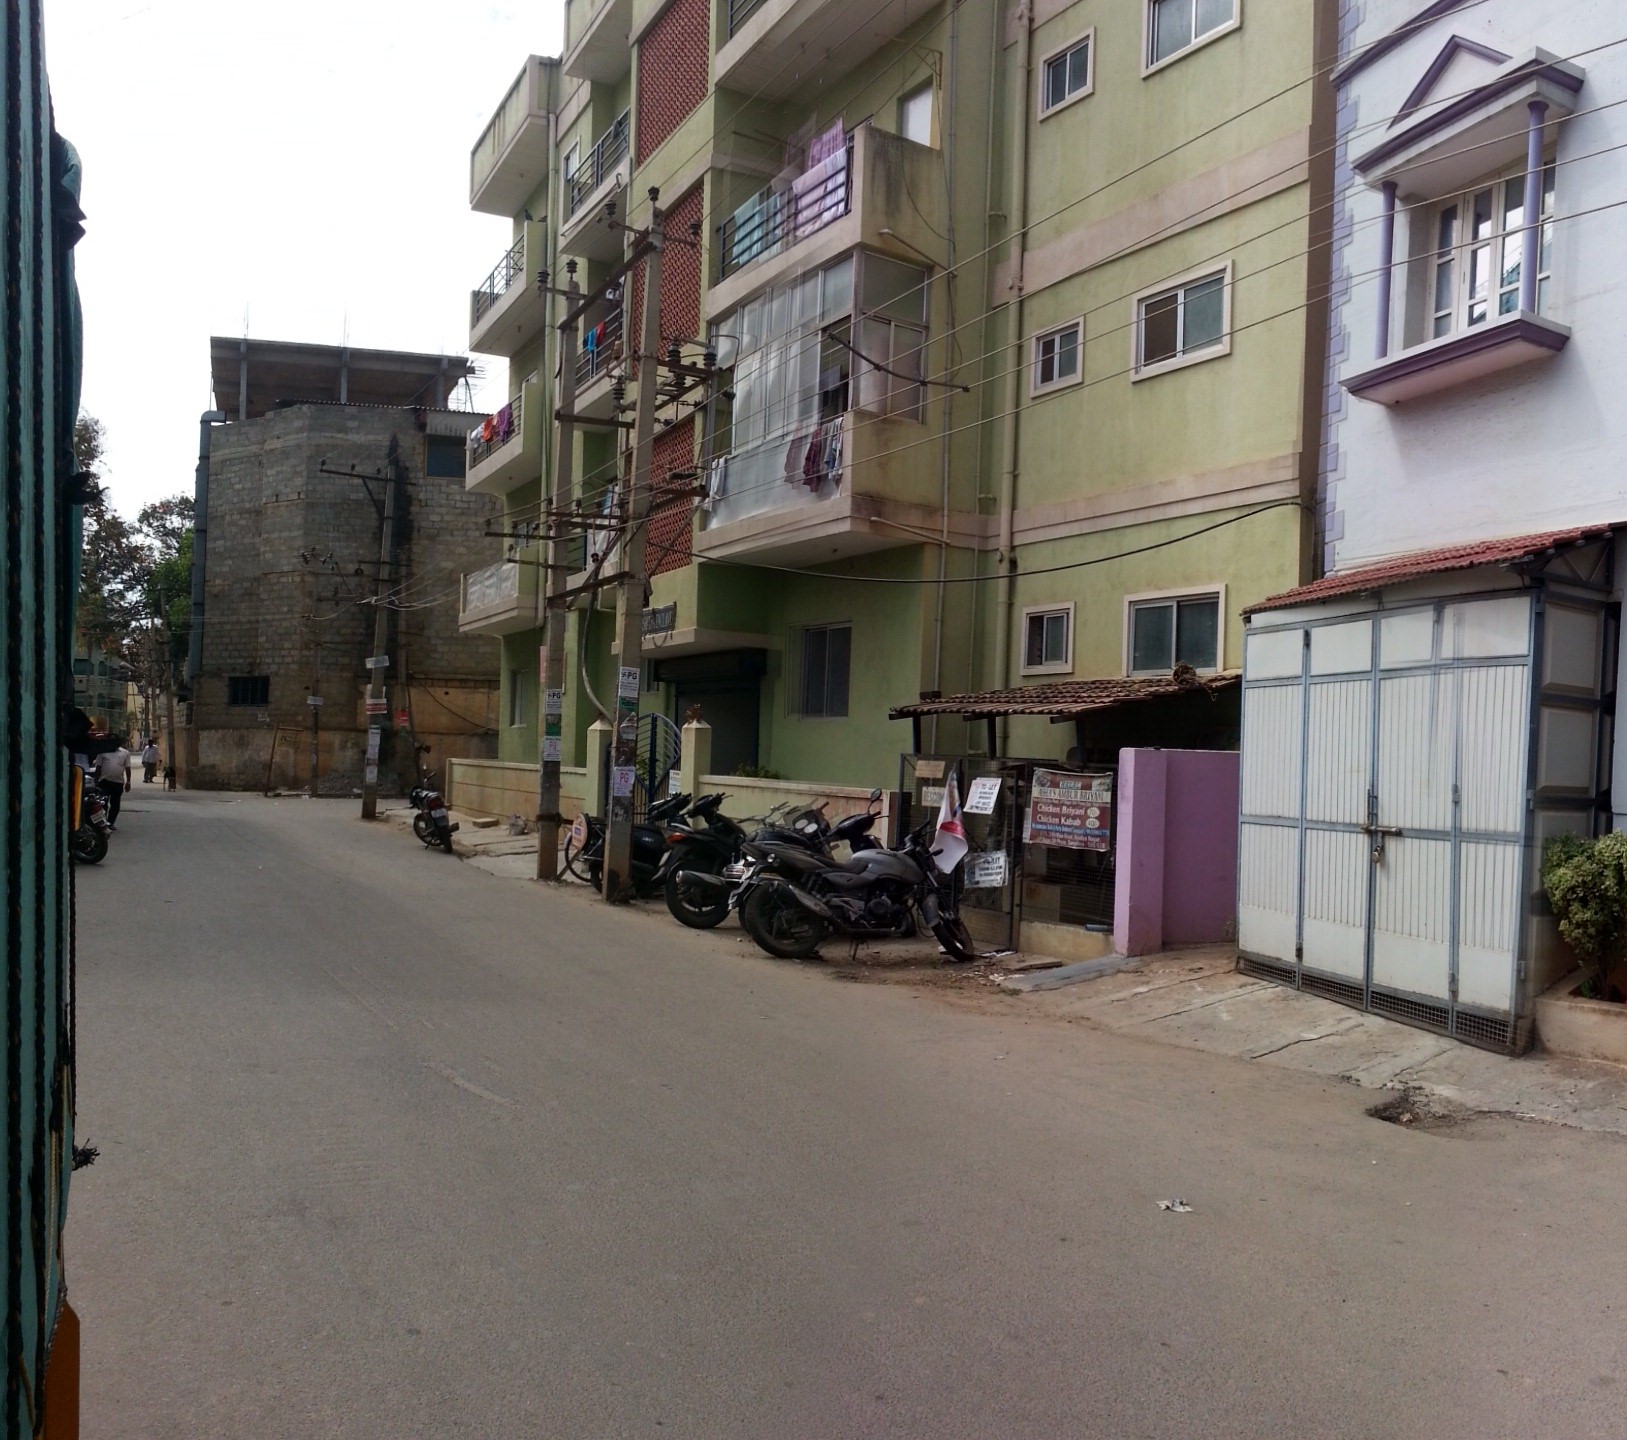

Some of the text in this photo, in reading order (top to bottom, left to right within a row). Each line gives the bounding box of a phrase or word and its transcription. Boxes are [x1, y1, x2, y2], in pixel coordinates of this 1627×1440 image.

[627, 672, 637, 680] PG
[619, 773, 629, 783] PG
[1037, 803, 1060, 813] Chicken
[1061, 805, 1085, 816] Briyani
[1037, 814, 1060, 824] Chicken
[1060, 816, 1081, 826] Kabab
